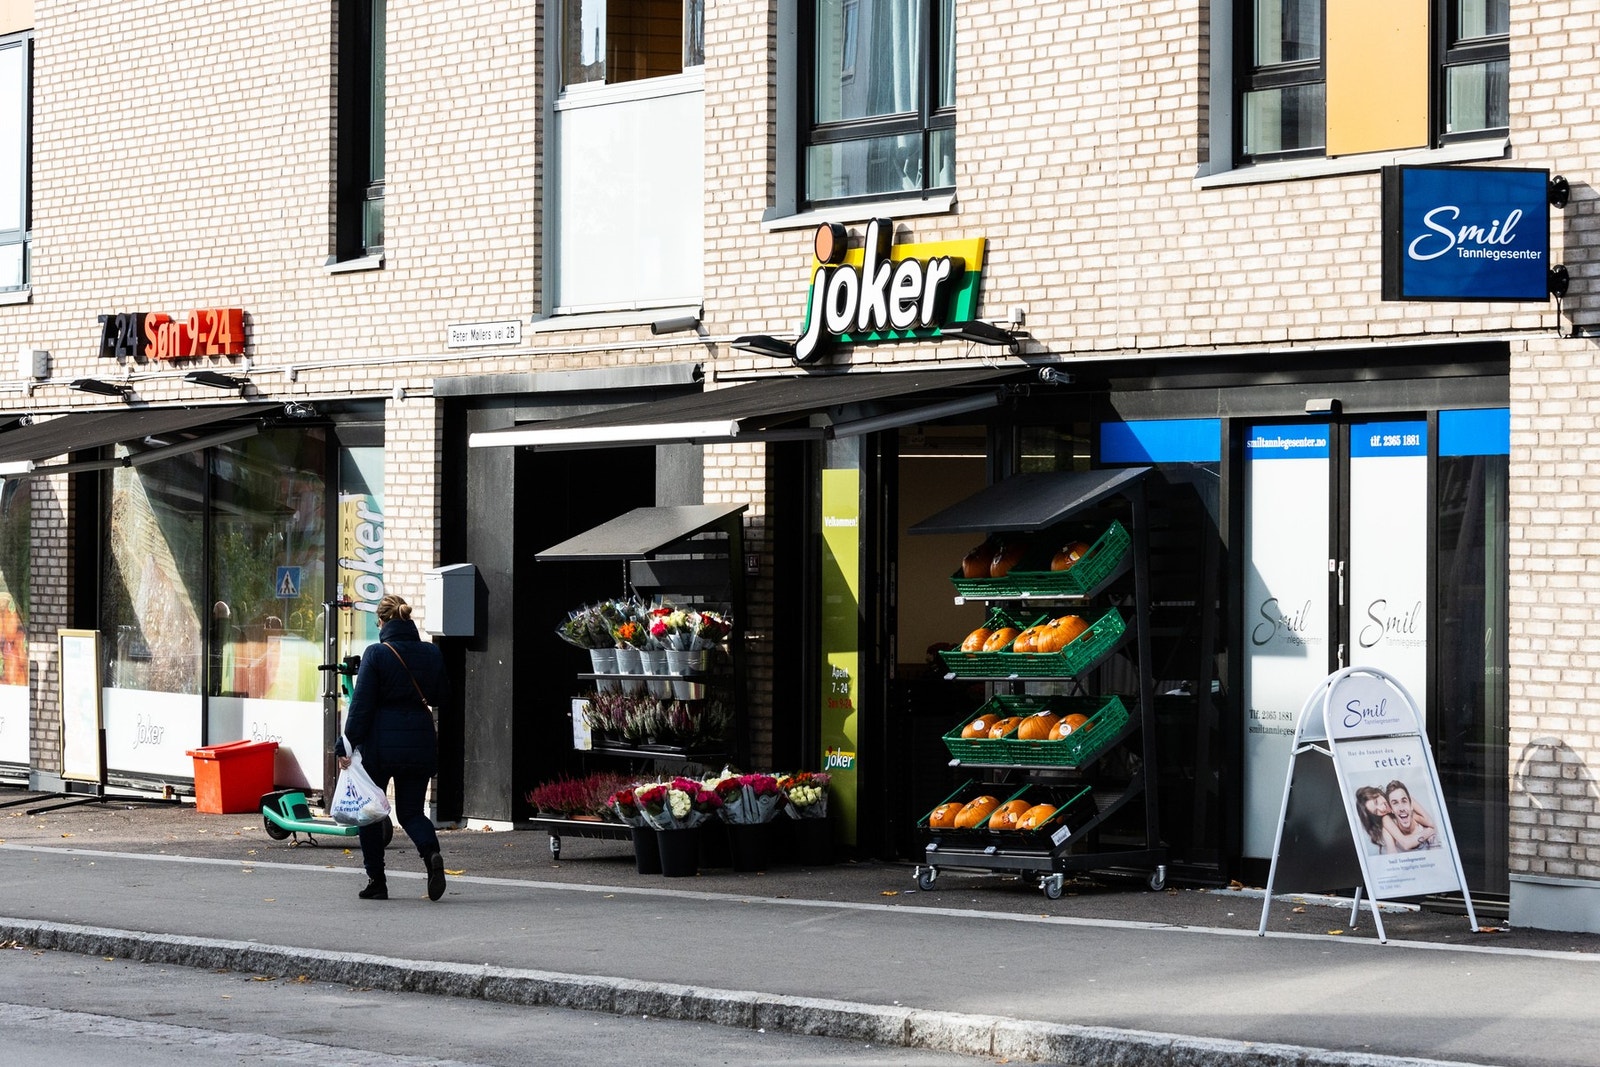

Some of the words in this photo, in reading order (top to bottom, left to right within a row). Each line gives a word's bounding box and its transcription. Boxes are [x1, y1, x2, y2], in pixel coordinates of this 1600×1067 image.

[1408, 205, 1523, 261] Smil
[1457, 247, 1542, 261] Tannlegesenter
[793, 217, 953, 363] joker
[144, 312, 181, 360] Søn
[187, 308, 232, 356] 9-24
[452, 330, 468, 342] Peter
[494, 327, 504, 340] vei
[506, 326, 515, 339] 2B
[1246, 436, 1326, 450] smiltannlegesenter.no
[1402, 434, 1420, 446] 1881
[824, 516, 858, 528] Velkommen!
[1252, 597, 1312, 646] Smil
[1359, 599, 1422, 648] Smil
[1343, 698, 1387, 728] Smil
[133, 713, 165, 750] joker
[824, 746, 853, 770] joker
[1374, 754, 1411, 768] rette?
